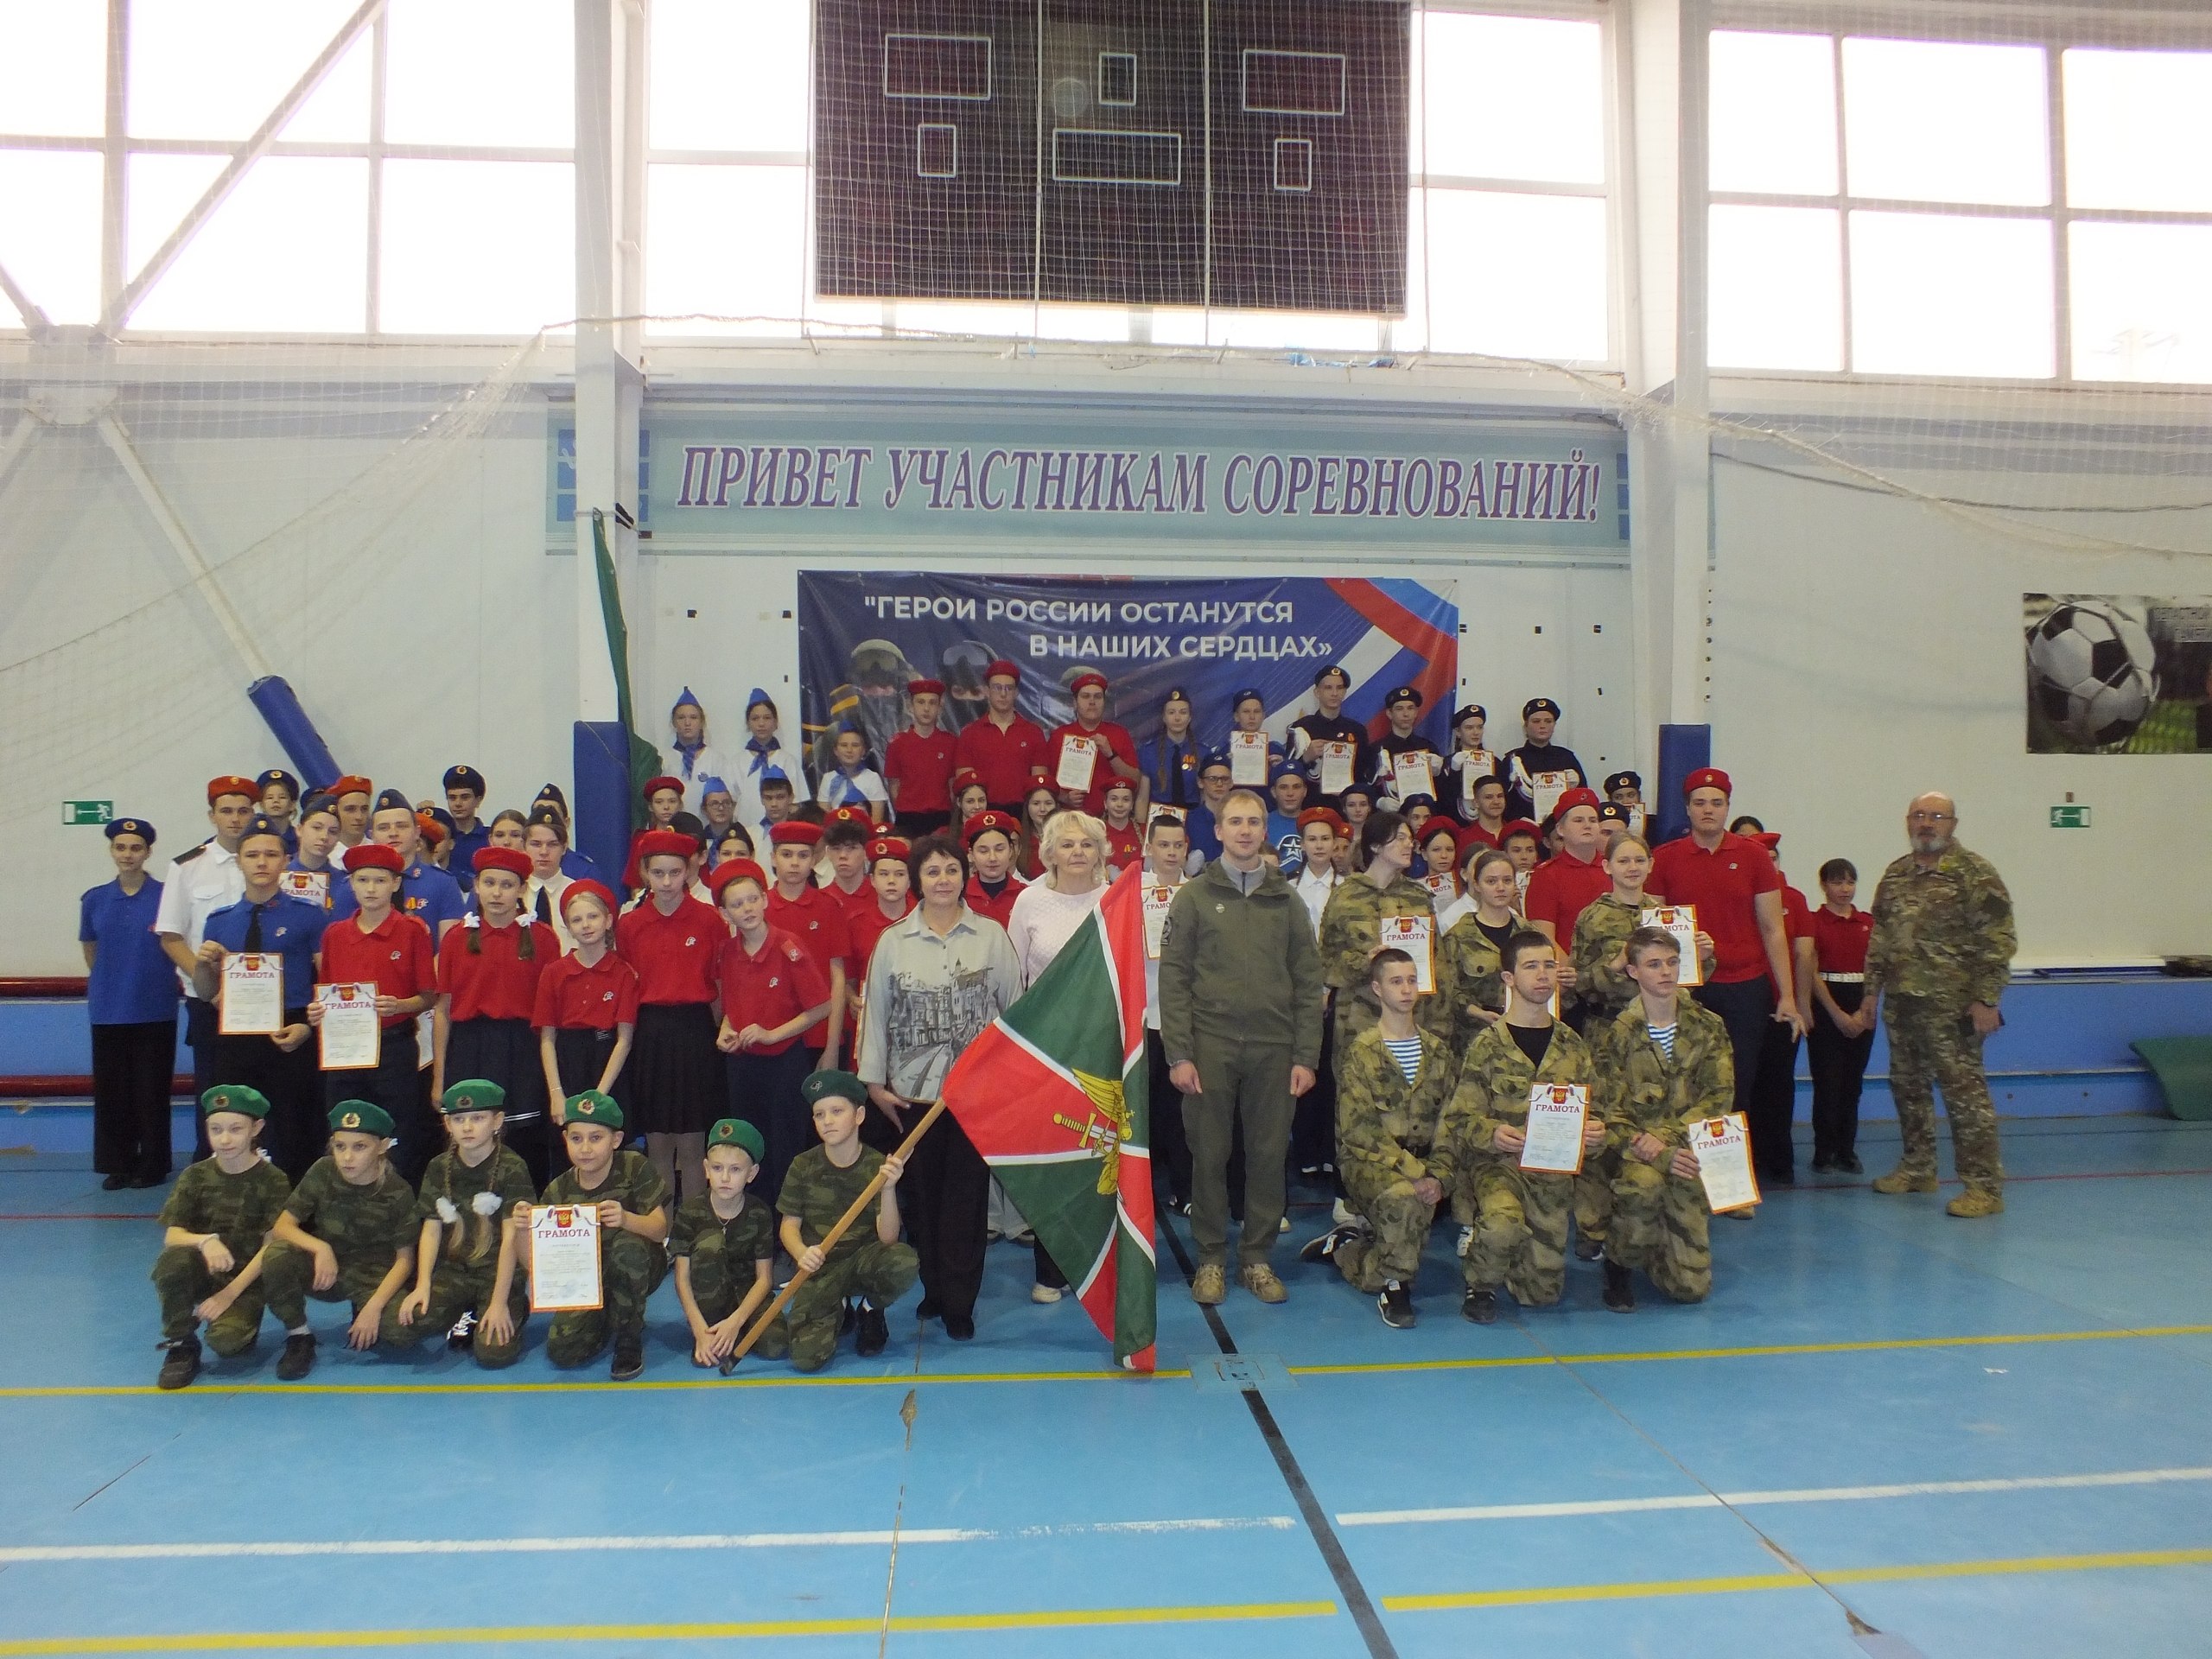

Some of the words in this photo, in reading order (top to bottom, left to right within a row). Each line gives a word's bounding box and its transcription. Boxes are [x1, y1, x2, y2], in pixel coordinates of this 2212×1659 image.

[677, 445, 872, 509] ПРИВЕТ
[884, 447, 1208, 513] УЧАСТНИКАМ
[1223, 449, 1600, 522] СОРЕВНОВАНИЙ!
[865, 596, 976, 620] "ГЕРОИ
[987, 598, 1111, 623] РОССИИ
[1120, 601, 1293, 624] ОСТАНУТСЯ
[1030, 634, 1049, 657] В
[1058, 635, 1171, 658] НАШИХ
[1179, 636, 1332, 661] СЕРДЦАХ»
[1386, 933, 1426, 942] ГРАМОТА
[325, 1001, 372, 1010] ГРАМОТА
[1535, 1104, 1580, 1113] ГРАМОТА
[1697, 1135, 1741, 1150] ГРАМОТА
[538, 1229, 590, 1239] ГРАМОТА
